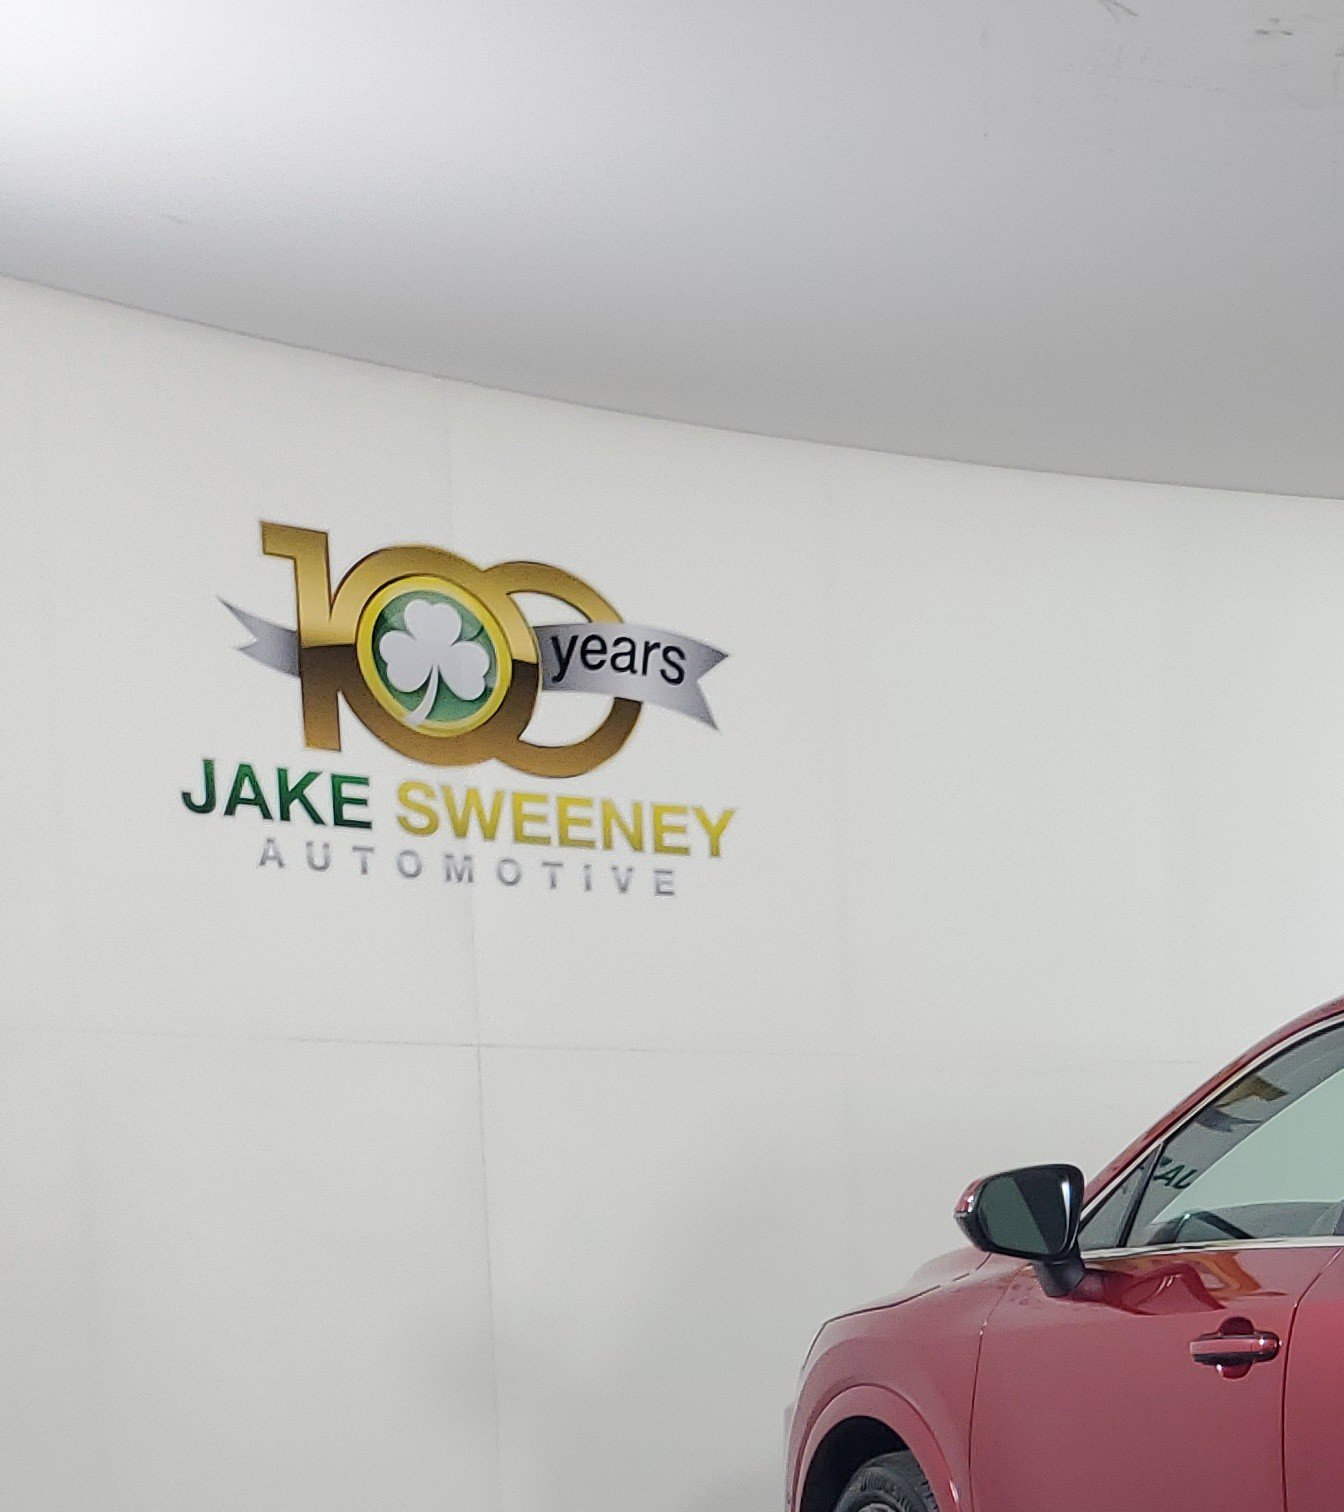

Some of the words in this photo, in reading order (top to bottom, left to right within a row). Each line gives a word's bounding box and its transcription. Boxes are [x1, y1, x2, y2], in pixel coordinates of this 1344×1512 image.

[261, 521, 642, 778] 100
[551, 634, 686, 684] years
[181, 758, 373, 829] JAKE
[396, 780, 737, 858] SWEENEY
[259, 838, 675, 896] AUTOMOTIVE
